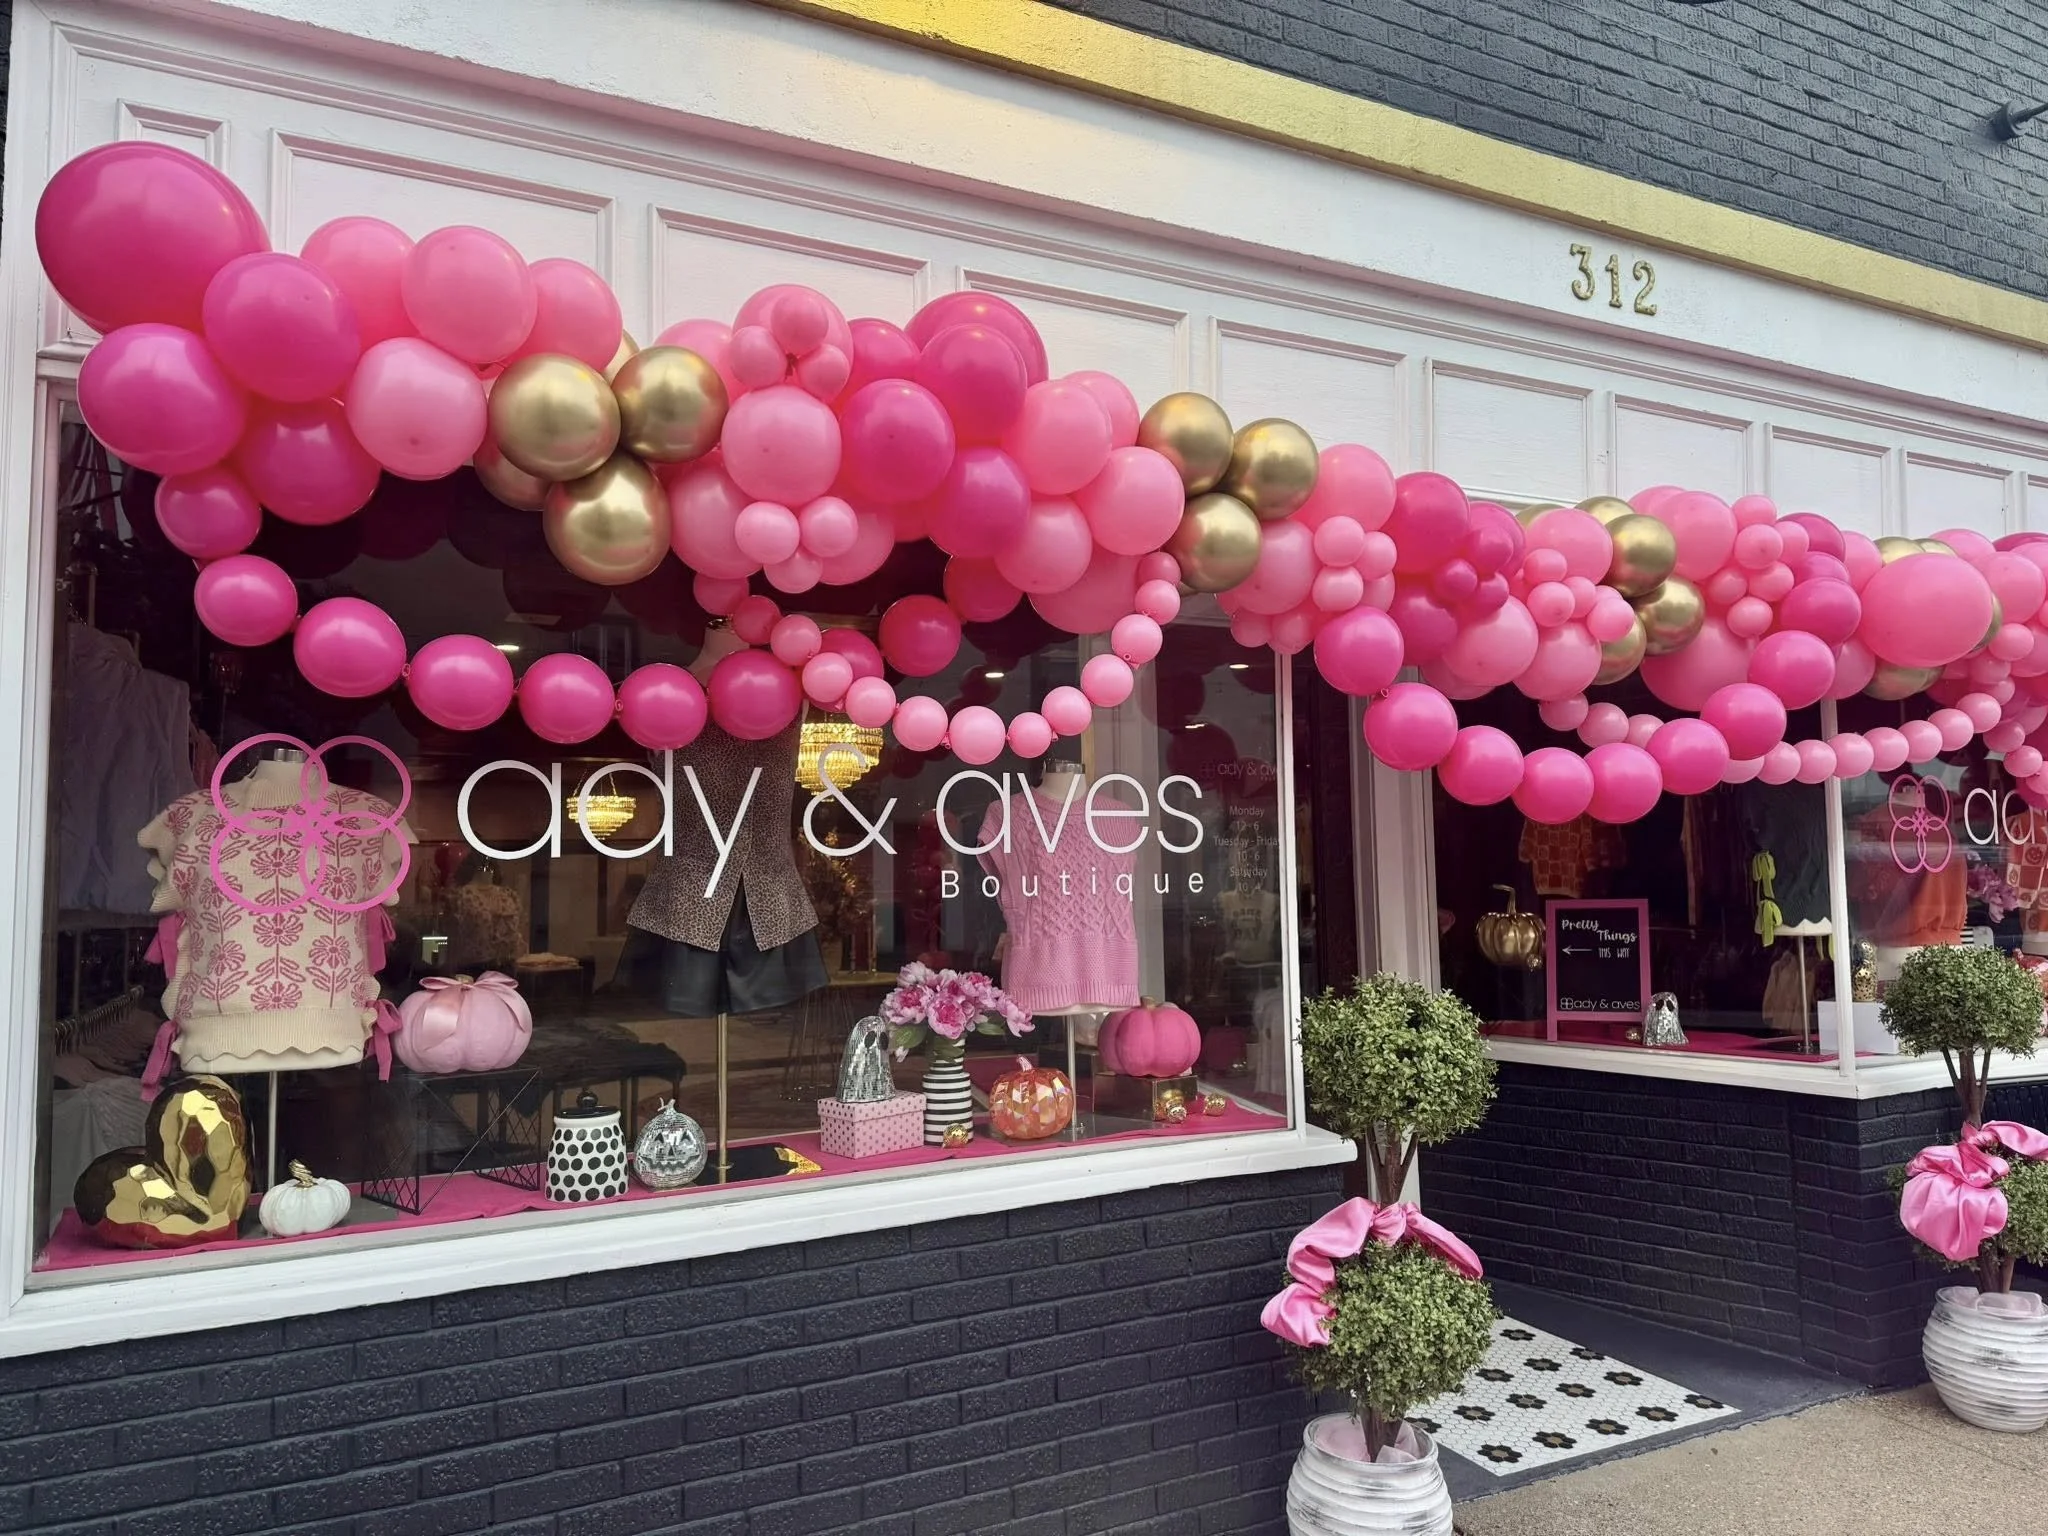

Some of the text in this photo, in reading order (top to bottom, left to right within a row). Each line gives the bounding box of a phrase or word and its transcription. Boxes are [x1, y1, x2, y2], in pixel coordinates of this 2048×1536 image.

[1569, 243, 1658, 316] 312
[1230, 805, 1264, 819] Monday
[1964, 787, 2047, 846] ad
[457, 743, 1204, 899] ady & aves
[1253, 820, 1260, 831] 6
[1213, 835, 1249, 849] Tuesday
[1256, 835, 1280, 847] Frida
[1238, 850, 1248, 861] 10
[1254, 850, 1260, 861] 6
[1230, 866, 1267, 879] Saturday
[941, 867, 1204, 902] Boutique
[1561, 919, 1599, 931] Pretty
[1596, 929, 1637, 943] Things
[1598, 947, 1630, 958] THIS WAY
[1574, 998, 1641, 1011] ady & aves
